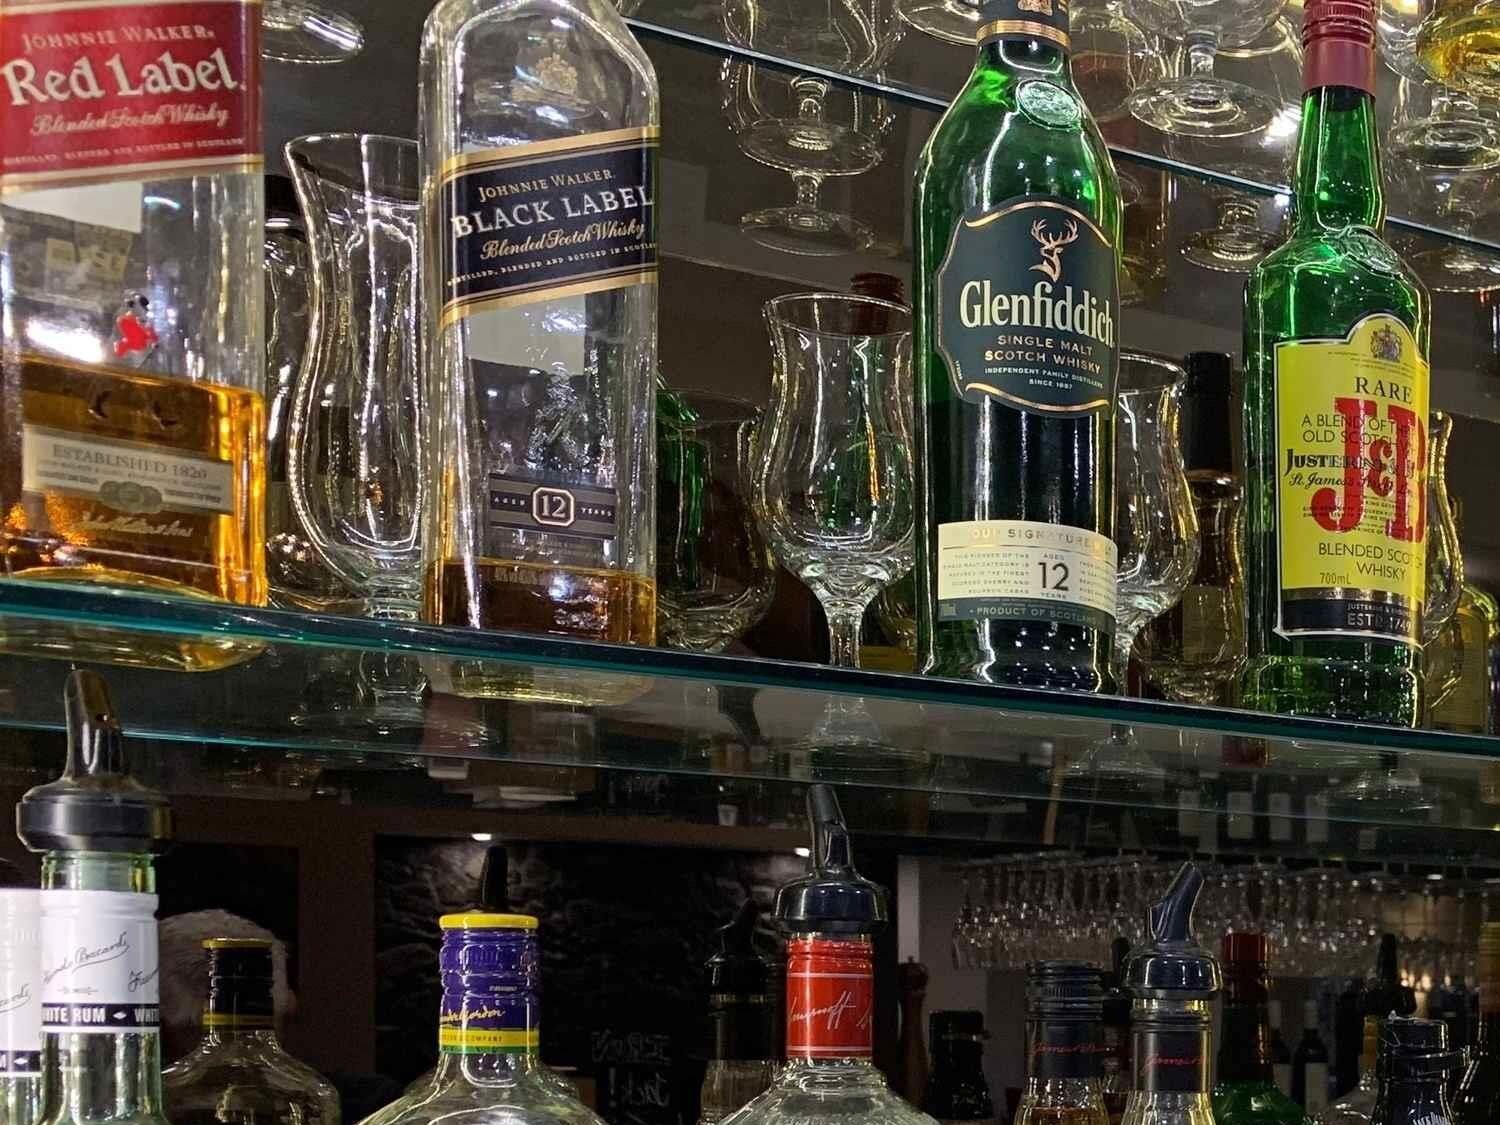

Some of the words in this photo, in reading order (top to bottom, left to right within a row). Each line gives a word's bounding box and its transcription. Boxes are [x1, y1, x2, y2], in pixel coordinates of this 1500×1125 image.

[21, 32, 117, 53] JOHNNIE
[121, 24, 213, 42] WALKER
[0, 56, 105, 106] Red
[105, 47, 238, 96] Label
[30, 112, 111, 136] Blended
[109, 107, 163, 129] Scotch
[160, 102, 229, 127] Whisky
[478, 178, 549, 203] JOHNNIE
[550, 169, 613, 187] WALKER
[450, 201, 555, 239] BLACK
[562, 185, 655, 218] LABEL
[480, 235, 546, 260] Blended
[546, 226, 592, 249] Scotch
[590, 218, 645, 240] Whisky
[960, 280, 1114, 348] Glenfiddich
[998, 335, 1054, 348] SINGLE
[1060, 341, 1094, 356] MALT
[984, 351, 1047, 362] SCOTCH
[1053, 354, 1101, 375] WHISKY
[984, 367, 1040, 376] INDEPENDENT
[1042, 369, 1069, 380] FAMILY
[1029, 379, 1053, 388] SINCE
[1355, 376, 1413, 404] RARE
[1301, 414, 1312, 427] A
[1368, 416, 1388, 431] OF
[1302, 430, 1335, 443] OLD
[53, 445, 168, 472] ESTABLISHED
[172, 464, 207, 480] 1820
[1310, 396, 1426, 543] J&B
[541, 495, 567, 517] 12
[580, 507, 612, 517] YEARS
[1318, 542, 1383, 559] BLENDED
[1038, 561, 1070, 592] 12
[1319, 572, 1351, 585] 700mL
[1356, 561, 1406, 581] WHISKY
[976, 606, 1026, 616] PRODUCT
[1031, 609, 1046, 618] OF
[73, 1005, 106, 1023] RUM
